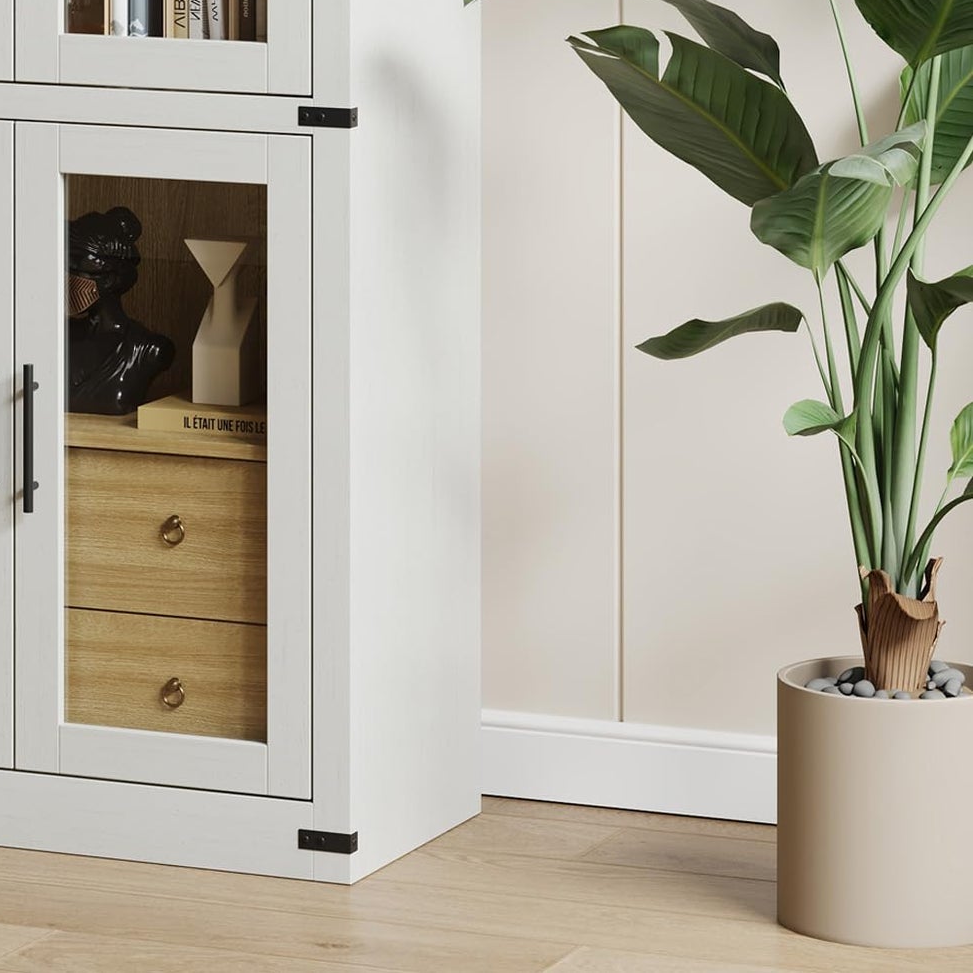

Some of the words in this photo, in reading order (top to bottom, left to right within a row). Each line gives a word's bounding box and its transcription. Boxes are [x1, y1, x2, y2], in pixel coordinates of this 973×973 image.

[183, 416, 191, 429] IL
[193, 415, 215, 431] ÉTAIT
[217, 418, 233, 432] UNE
[235, 420, 254, 434] FOIS
